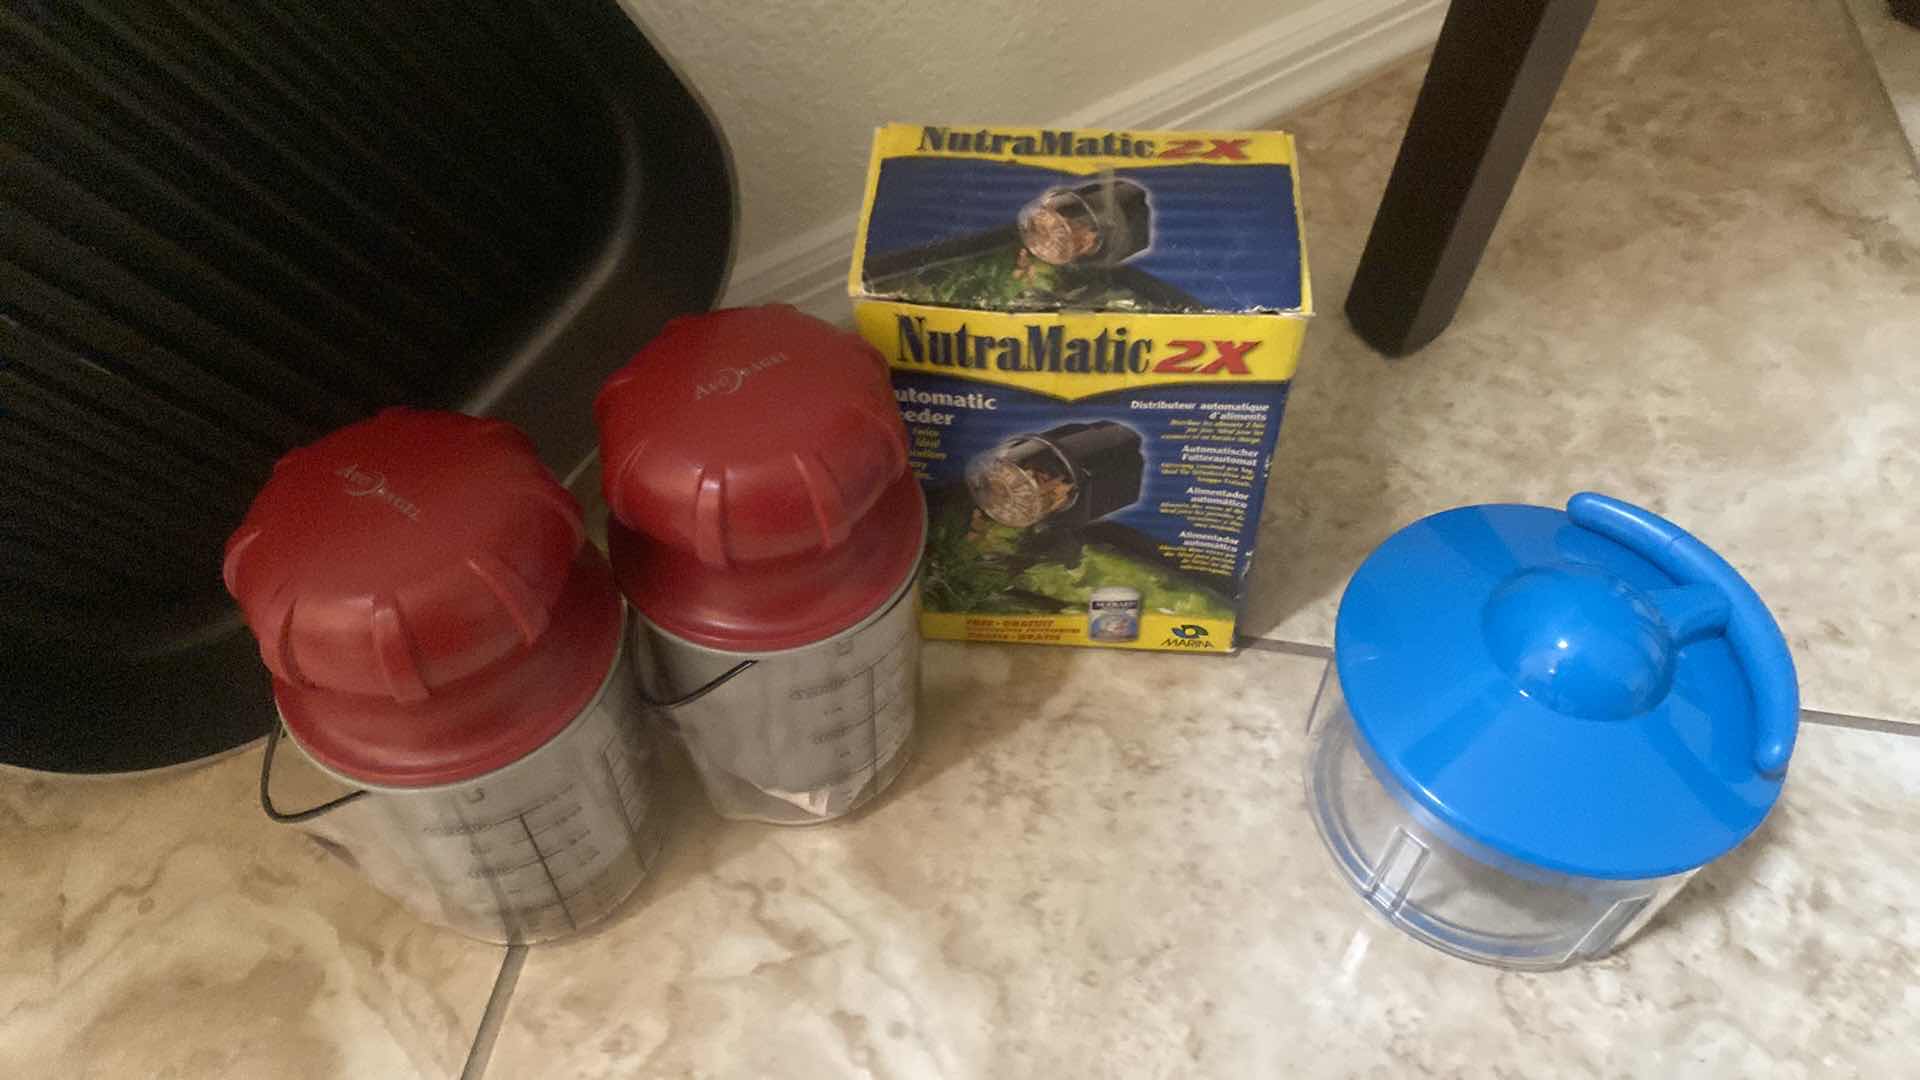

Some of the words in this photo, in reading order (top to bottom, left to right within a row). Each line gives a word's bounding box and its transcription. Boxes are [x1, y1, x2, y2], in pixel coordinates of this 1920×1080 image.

[917, 125, 1155, 159] NutraMatic
[1157, 138, 1252, 161] 2X
[896, 313, 1153, 374] NutraMatic
[1153, 340, 1263, 375] 2X
[894, 387, 998, 410] utomatic
[1130, 400, 1196, 410] Distributeur
[1200, 402, 1270, 412] automatique
[899, 408, 956, 425] eder
[1181, 444, 1259, 457] Automatischer
[1186, 487, 1250, 501] Alimentador
[1178, 531, 1239, 545] Alimentador
[1161, 637, 1216, 649] MARINA
